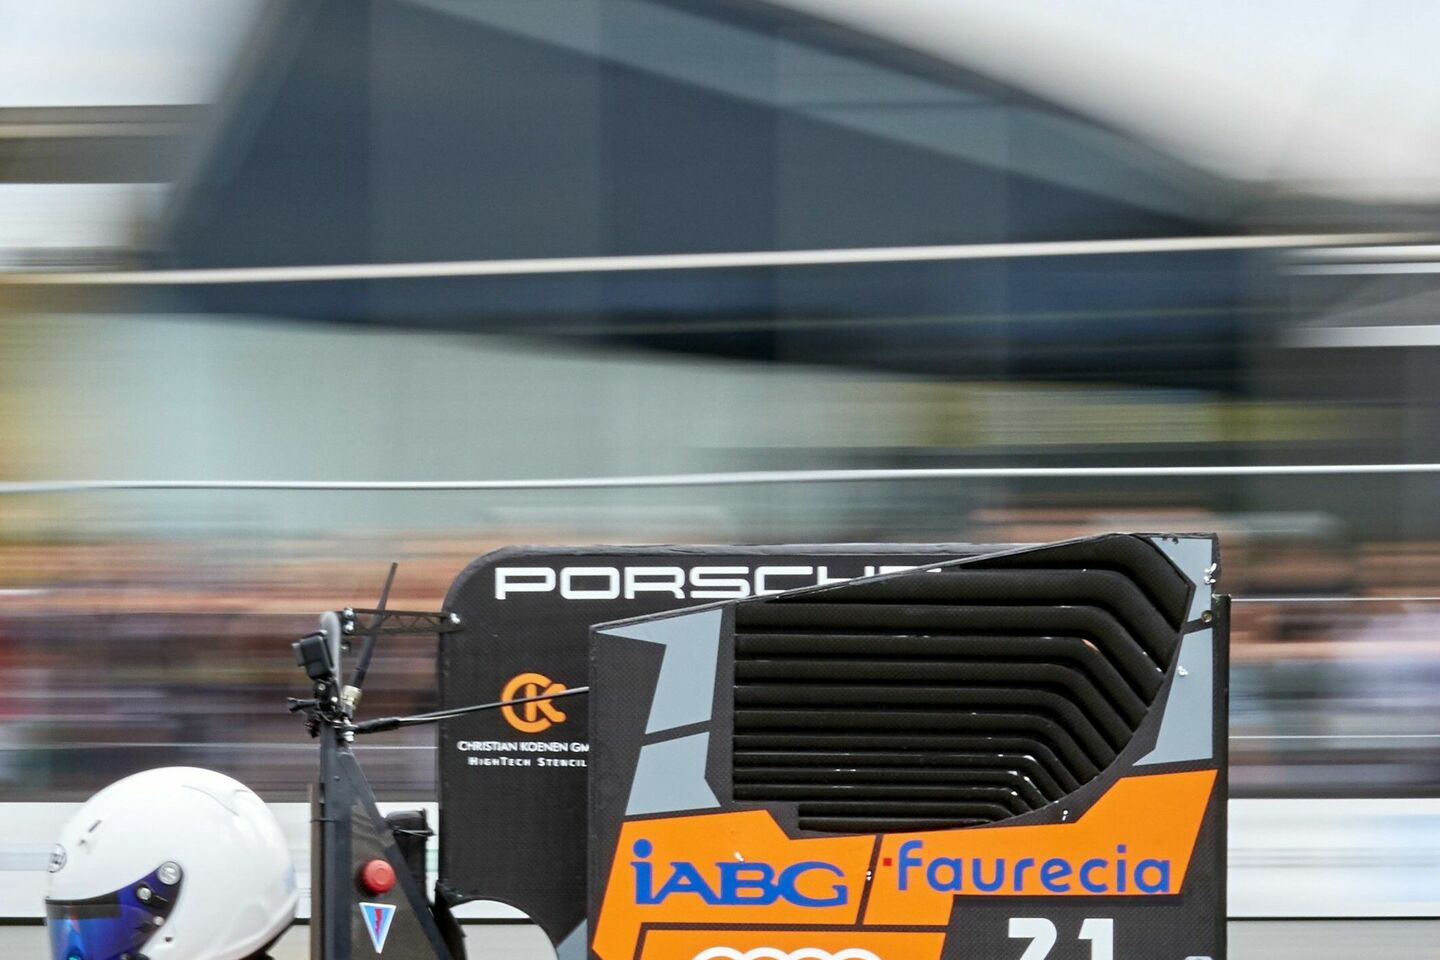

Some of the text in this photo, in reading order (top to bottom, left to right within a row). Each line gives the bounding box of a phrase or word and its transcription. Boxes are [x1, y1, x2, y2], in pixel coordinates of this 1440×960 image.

[457, 741, 518, 752] CHRISTIAN
[520, 742, 569, 752] KOENEN
[897, 840, 1172, 894] faurecia
